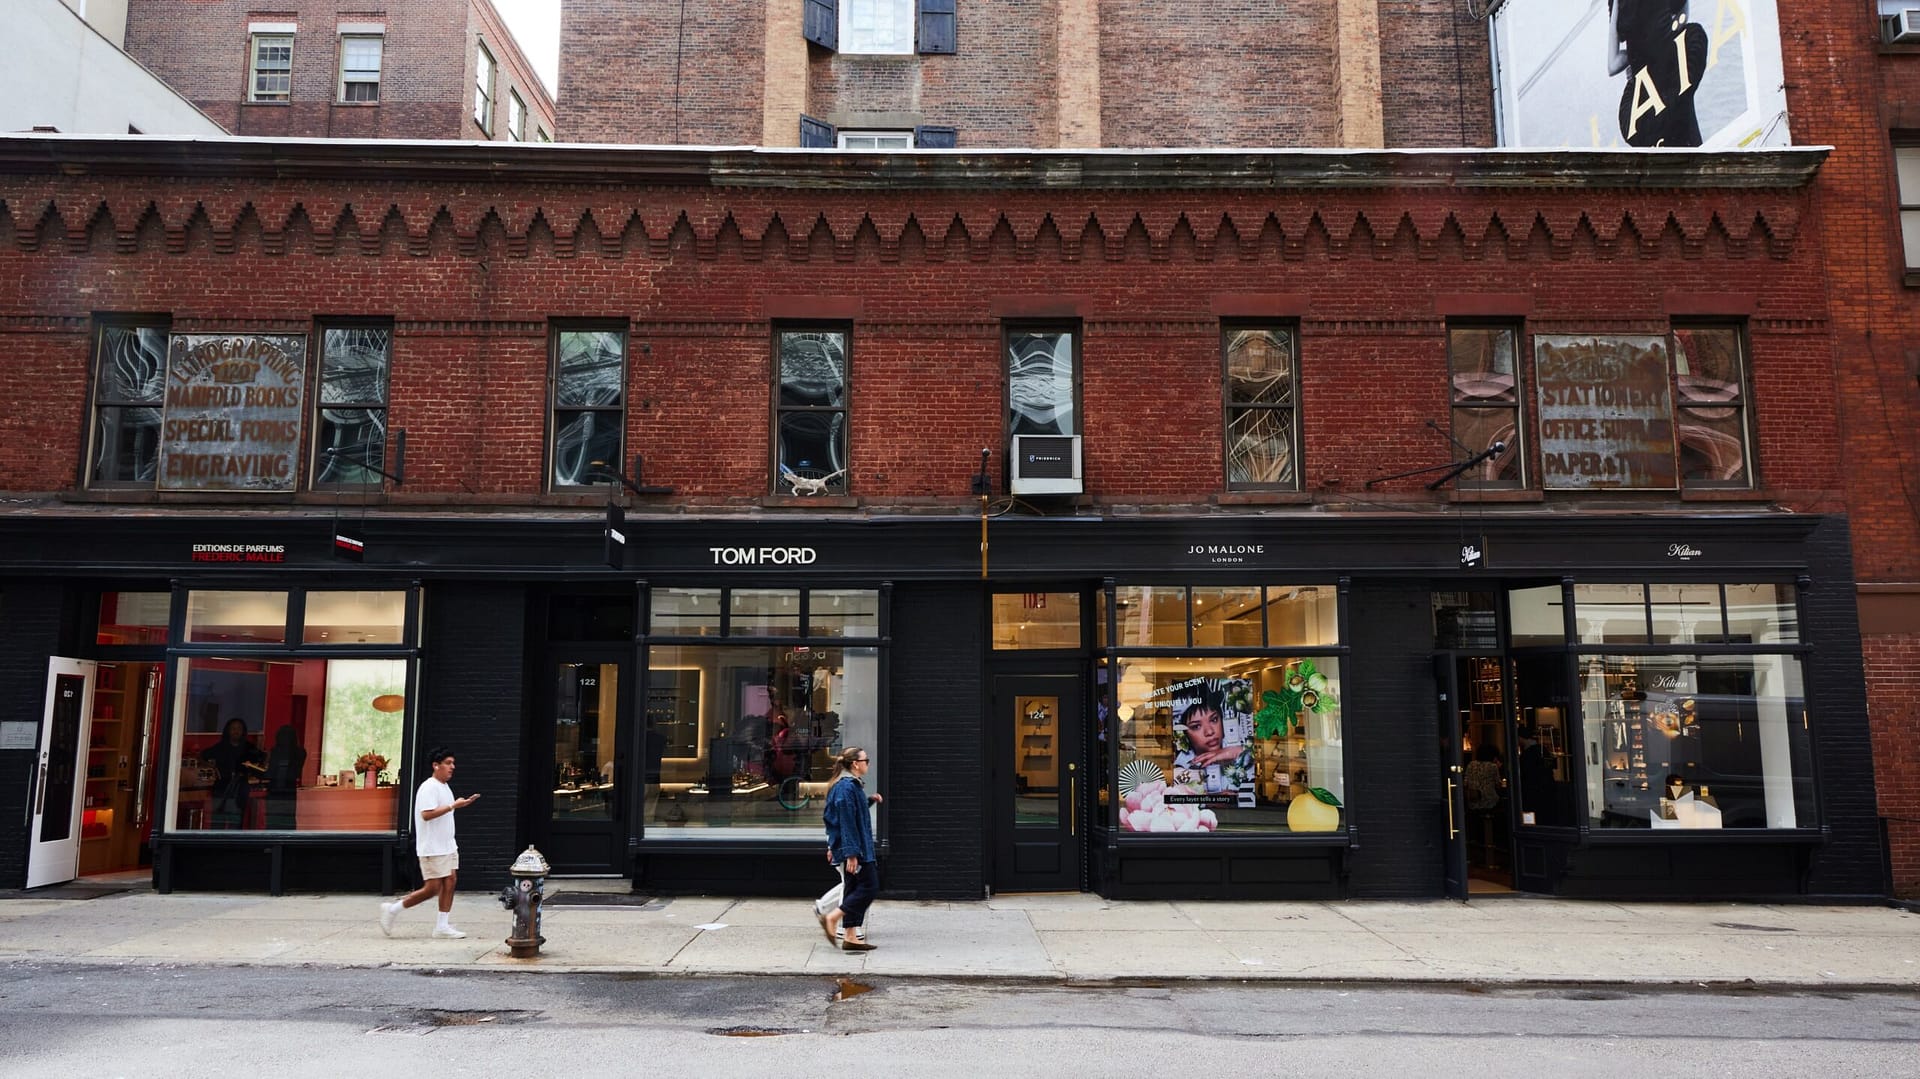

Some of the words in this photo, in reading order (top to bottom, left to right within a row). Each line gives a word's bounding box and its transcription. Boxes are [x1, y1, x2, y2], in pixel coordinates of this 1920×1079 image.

[168, 386, 242, 408] MANIFOLD
[245, 386, 299, 408] BOOKS
[165, 419, 235, 442] SPECIAL
[240, 419, 298, 444] FORMS
[1542, 419, 1597, 441] OFFICE
[167, 454, 289, 480] ENGRAVING
[1544, 453, 1601, 475] PAPER
[193, 544, 232, 552] EDITIONS
[233, 544, 245, 552] DE
[246, 545, 285, 553] PARFUMS
[709, 547, 755, 564] TOM
[760, 547, 816, 564] FORD
[1187, 545, 1204, 554] JO
[1208, 545, 1264, 554] MALONE
[1667, 543, 1702, 557] Kilian
[192, 552, 244, 561] FREDERIC
[246, 552, 285, 562] MALLE
[580, 678, 596, 686] 122
[1141, 687, 1165, 699] EATE
[1165, 682, 1183, 693] YOUR
[1184, 676, 1206, 688] SCENT
[1652, 674, 1688, 689] Kilian
[1154, 698, 1187, 708] UNIQUELY
[1188, 697, 1202, 705] YOU
[1029, 711, 1045, 719] 124
